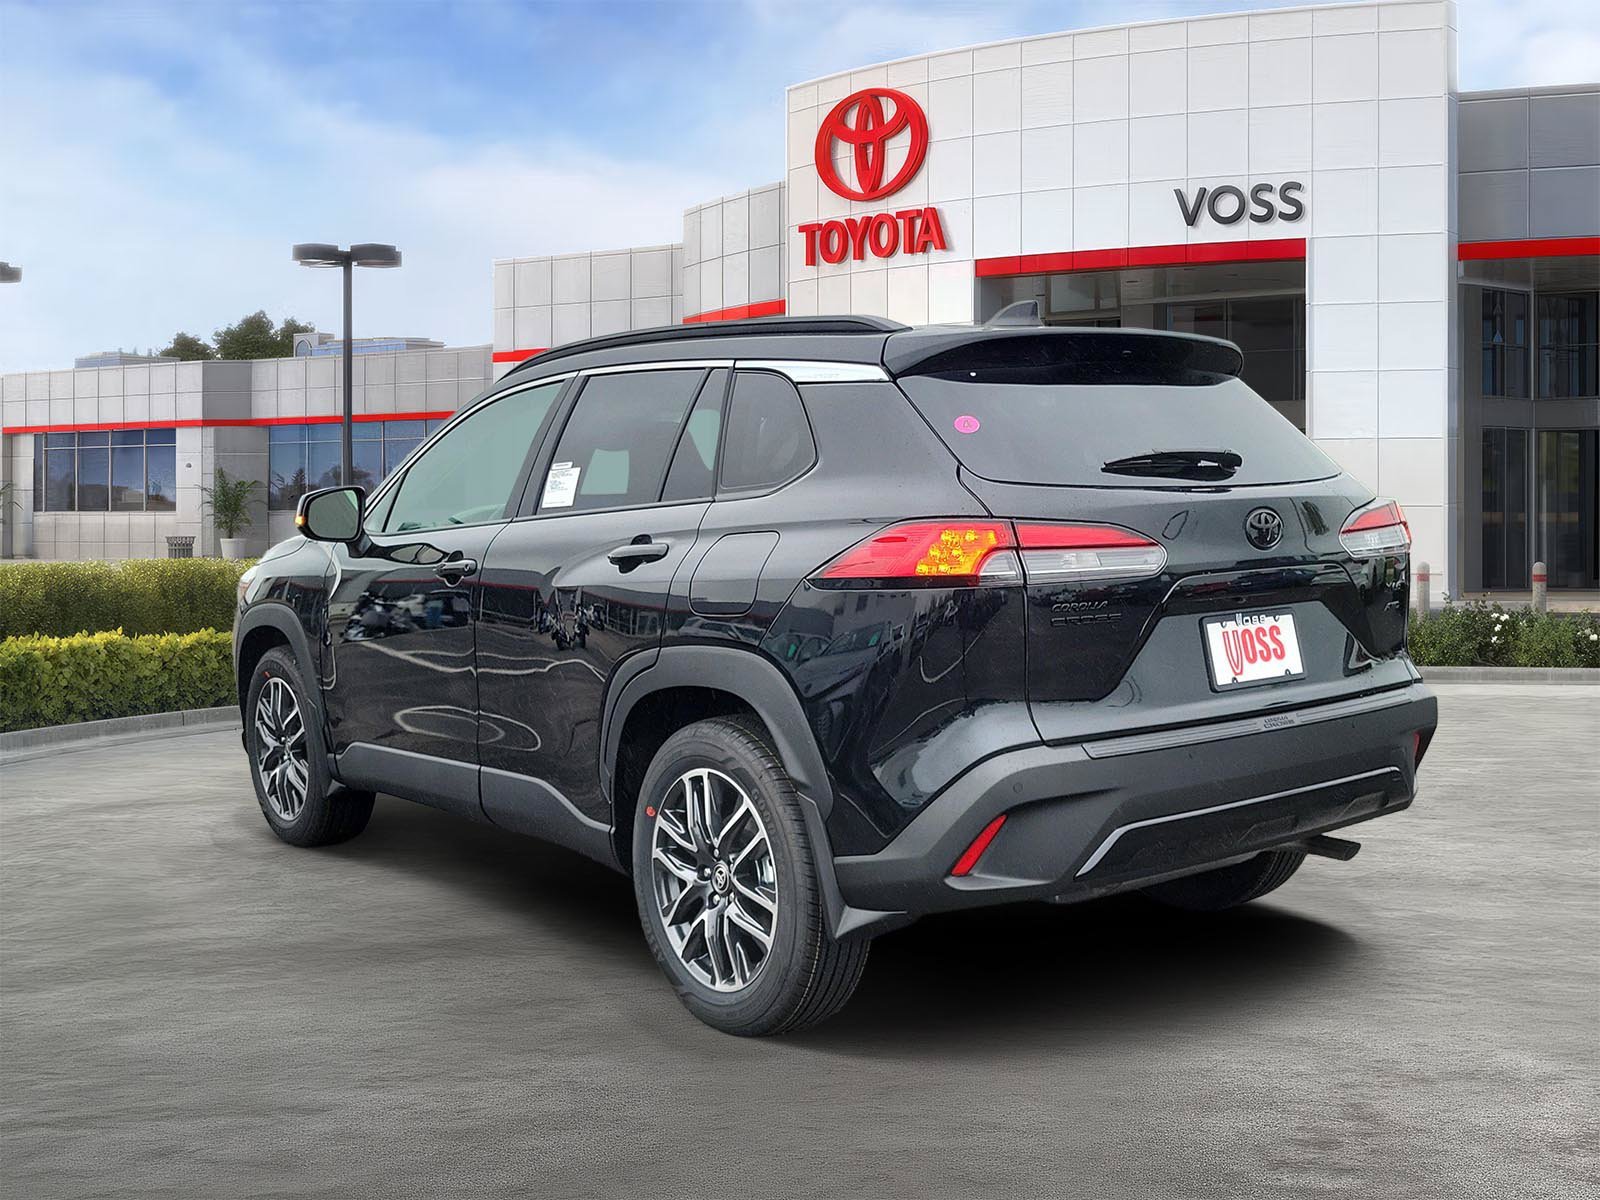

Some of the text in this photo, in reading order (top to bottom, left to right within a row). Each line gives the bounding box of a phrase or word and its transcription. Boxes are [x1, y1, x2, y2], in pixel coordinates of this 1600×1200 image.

[1173, 181, 1303, 226] VOSS
[798, 207, 947, 266] TOYOTA
[1222, 625, 1286, 676] VOSS
